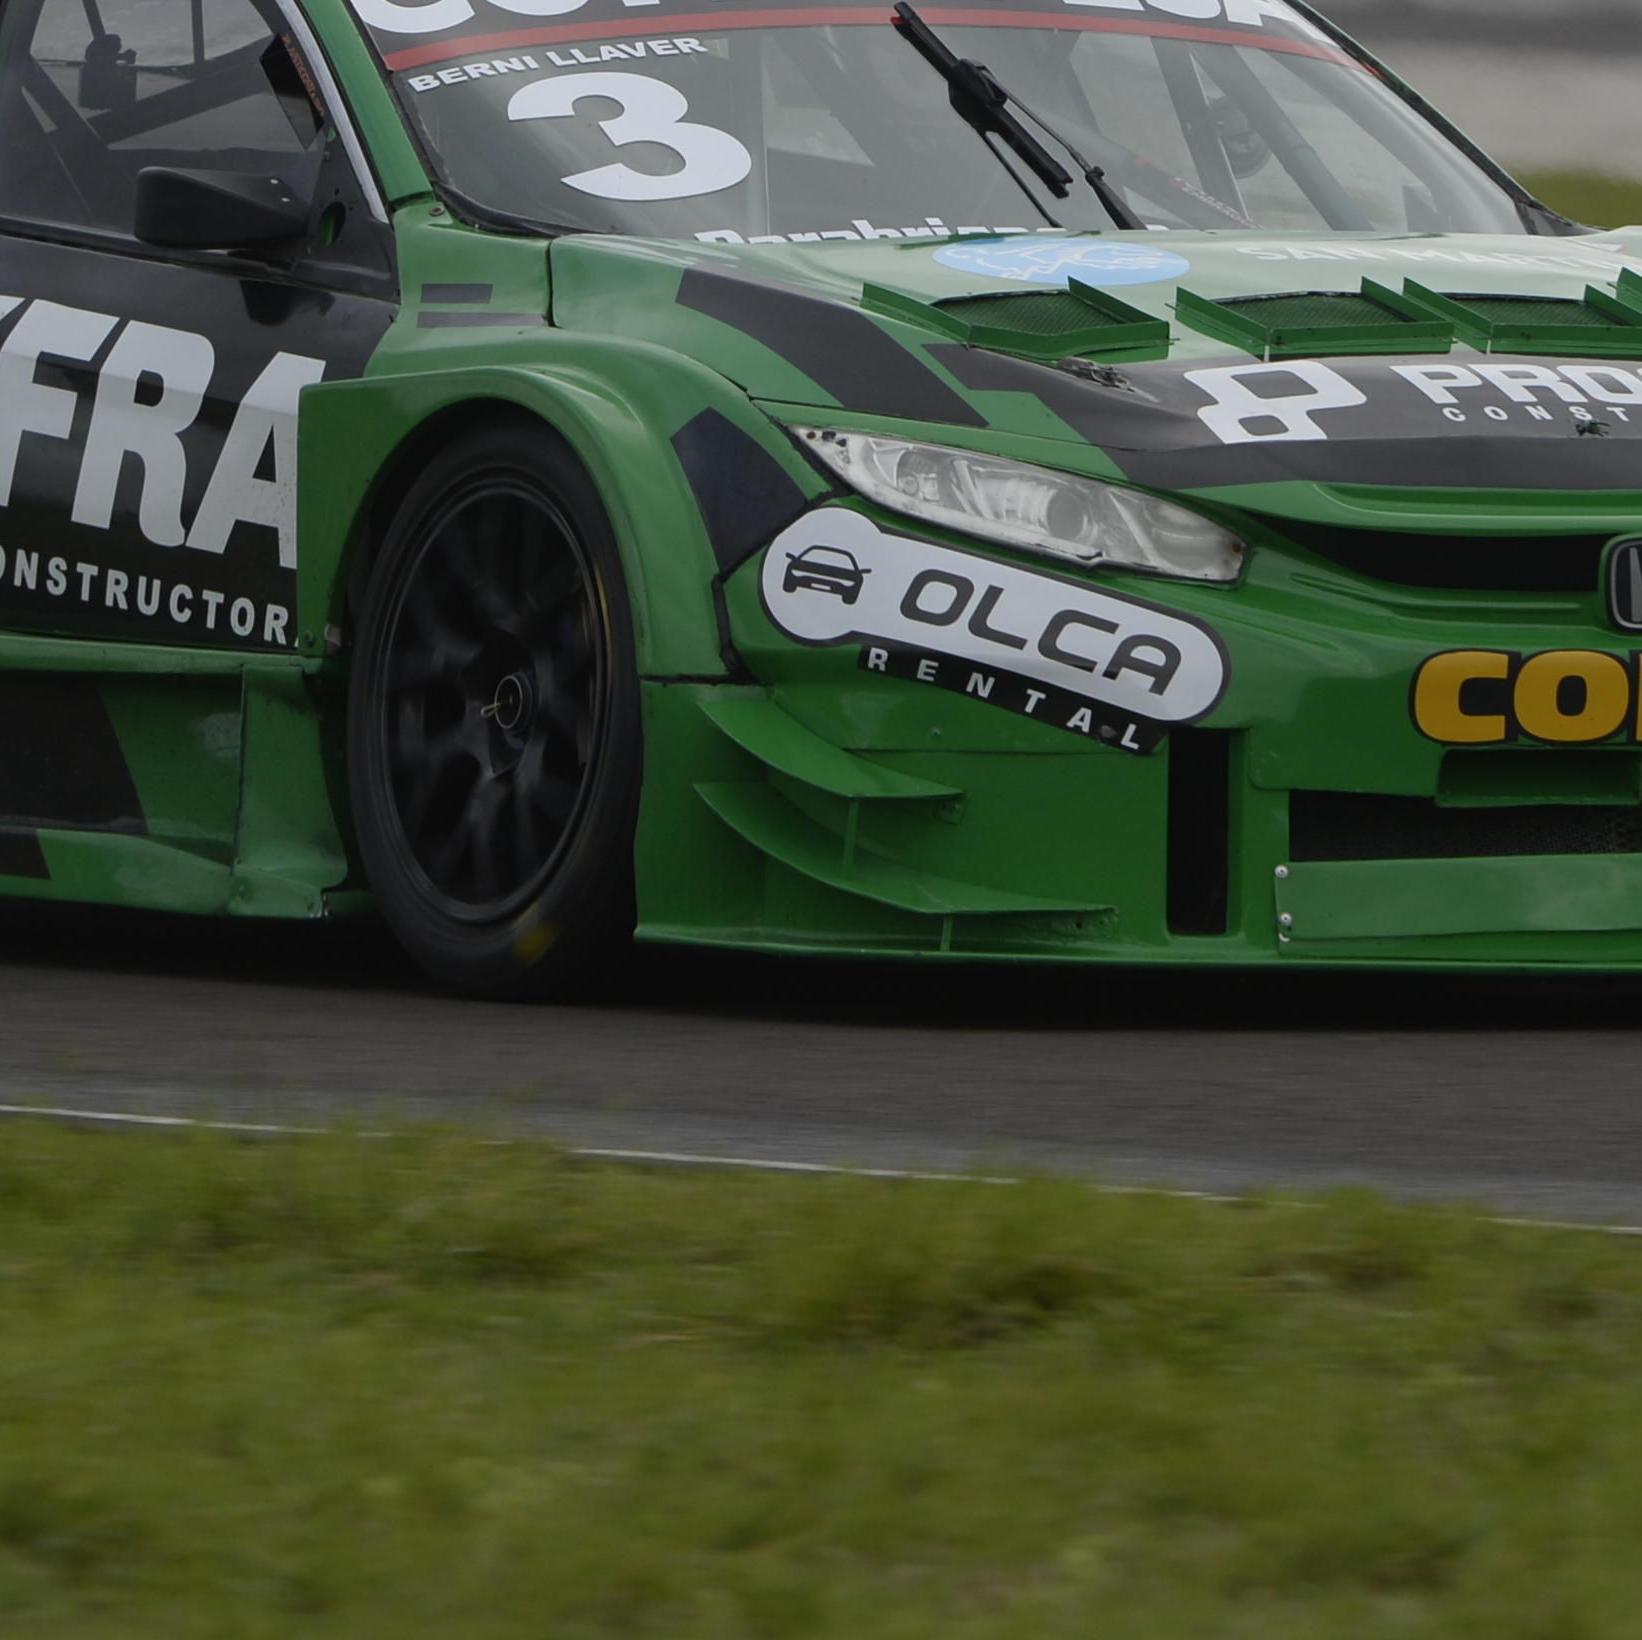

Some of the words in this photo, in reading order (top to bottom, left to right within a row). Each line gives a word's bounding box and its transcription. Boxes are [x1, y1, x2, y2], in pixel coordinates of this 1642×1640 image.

[407, 55, 540, 93] BERNI
[544, 37, 708, 68] LLAVER
[507, 71, 752, 201] 3
[1236, 246, 1388, 261] SAN
[899, 568, 1182, 697] OLCA
[866, 646, 1141, 751] RENTAL
